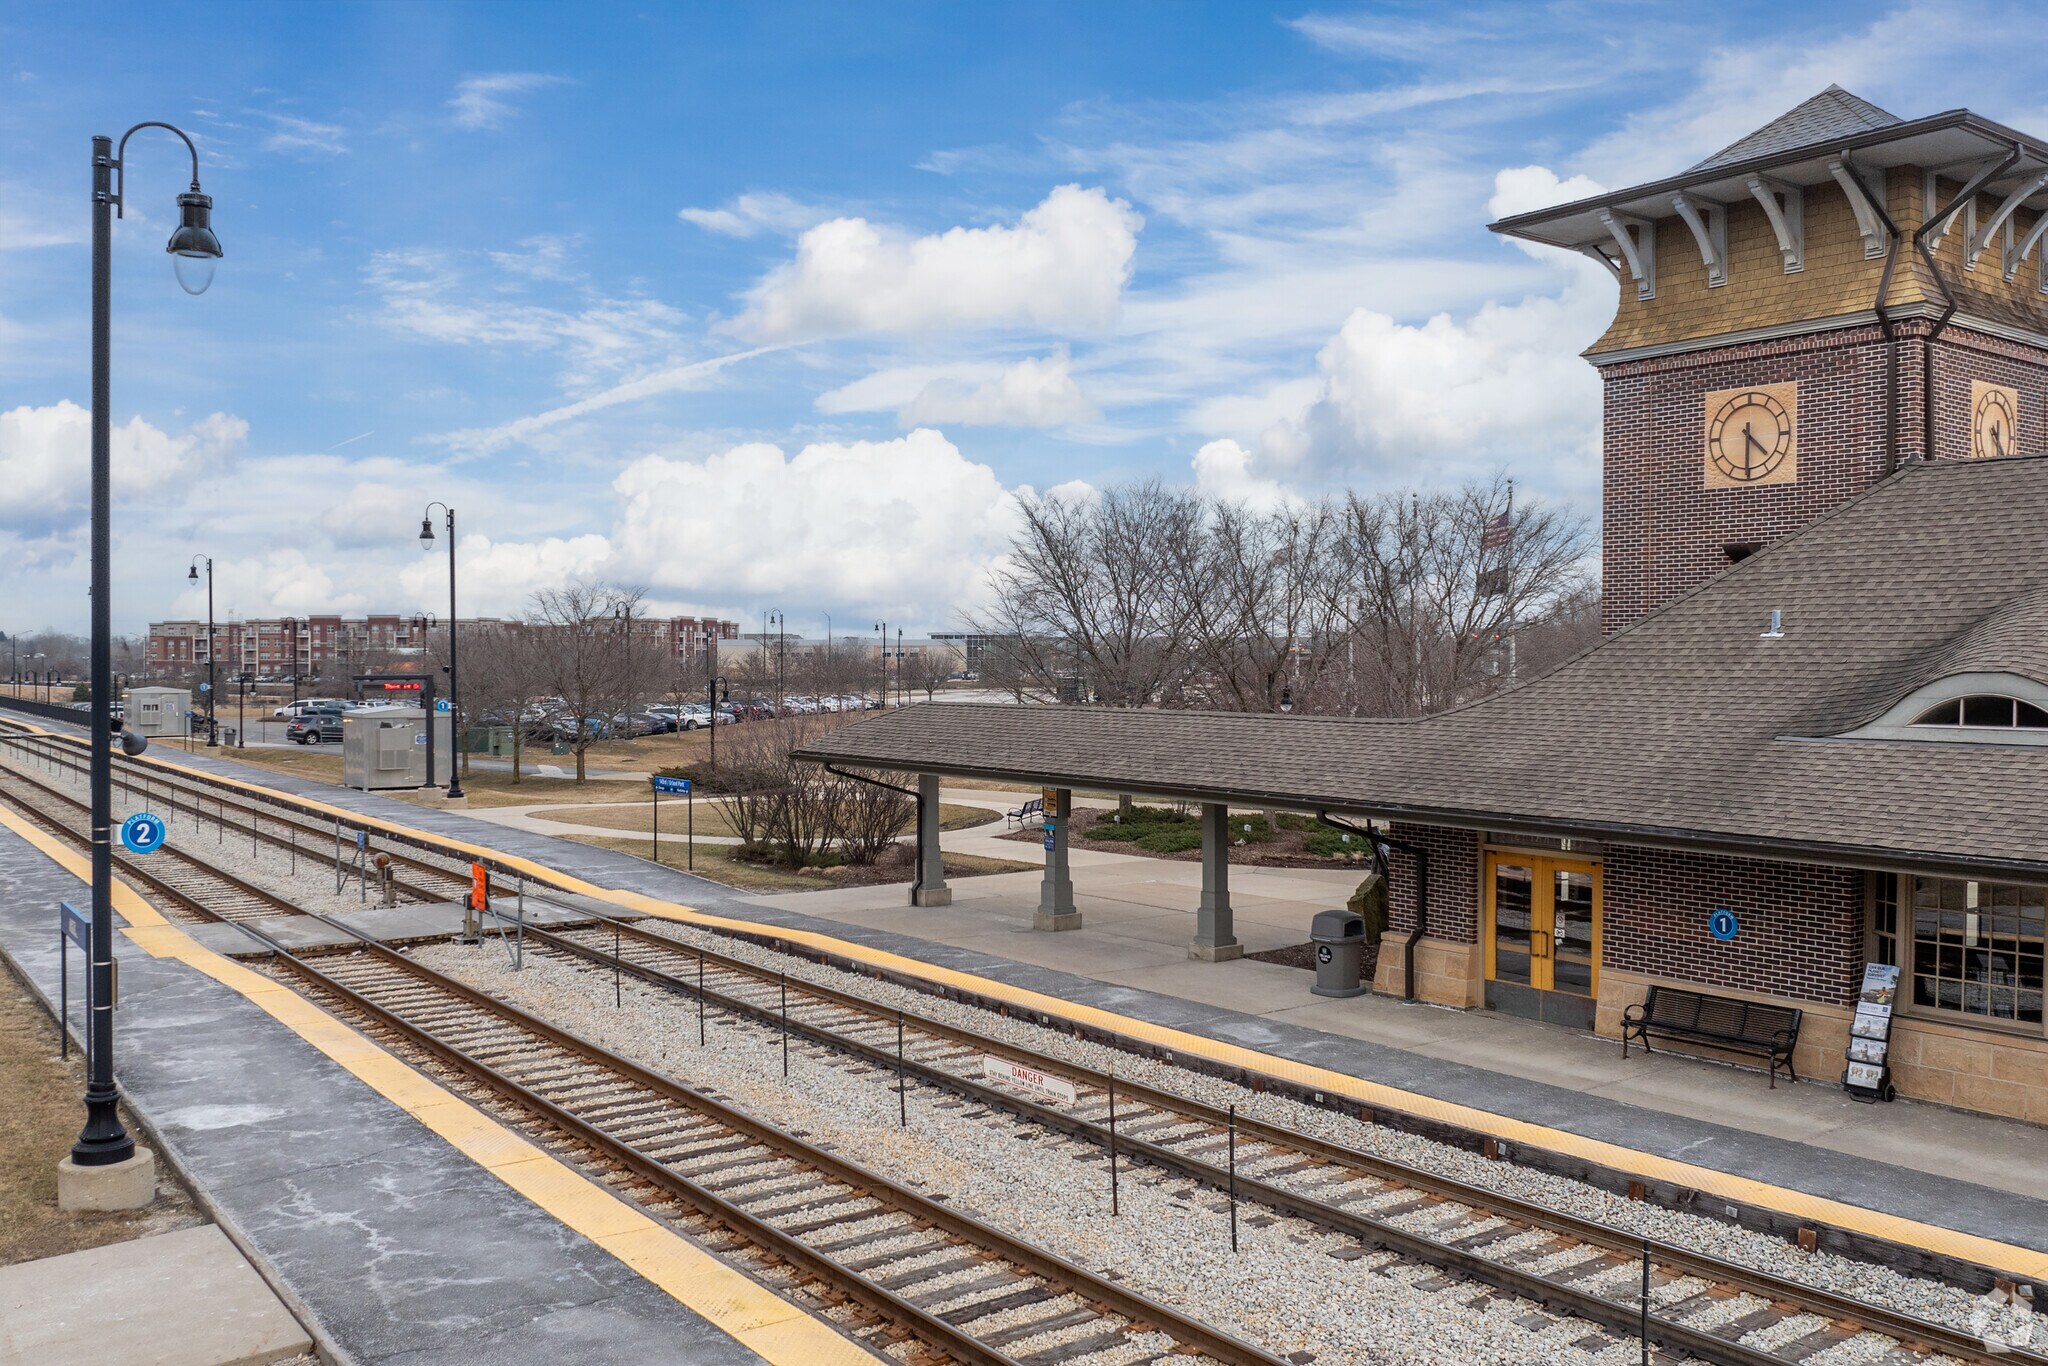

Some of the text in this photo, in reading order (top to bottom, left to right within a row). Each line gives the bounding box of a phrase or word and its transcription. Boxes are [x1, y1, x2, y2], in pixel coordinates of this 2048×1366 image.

[127, 814, 160, 825] PLATFORM
[136, 823, 151, 843] 2
[1713, 910, 1734, 919] PLATFORM
[1719, 917, 1726, 932] 1
[1012, 1067, 1043, 1085] DANGER
[998, 1072, 1011, 1082] BEHIND
[1011, 1077, 1025, 1087] YELLOW
[1026, 1082, 1034, 1090] LINE
[1034, 1085, 1045, 1094] UNTIL
[1045, 1088, 1056, 1098] TRAIN
[1057, 1092, 1069, 1102] STOPS
